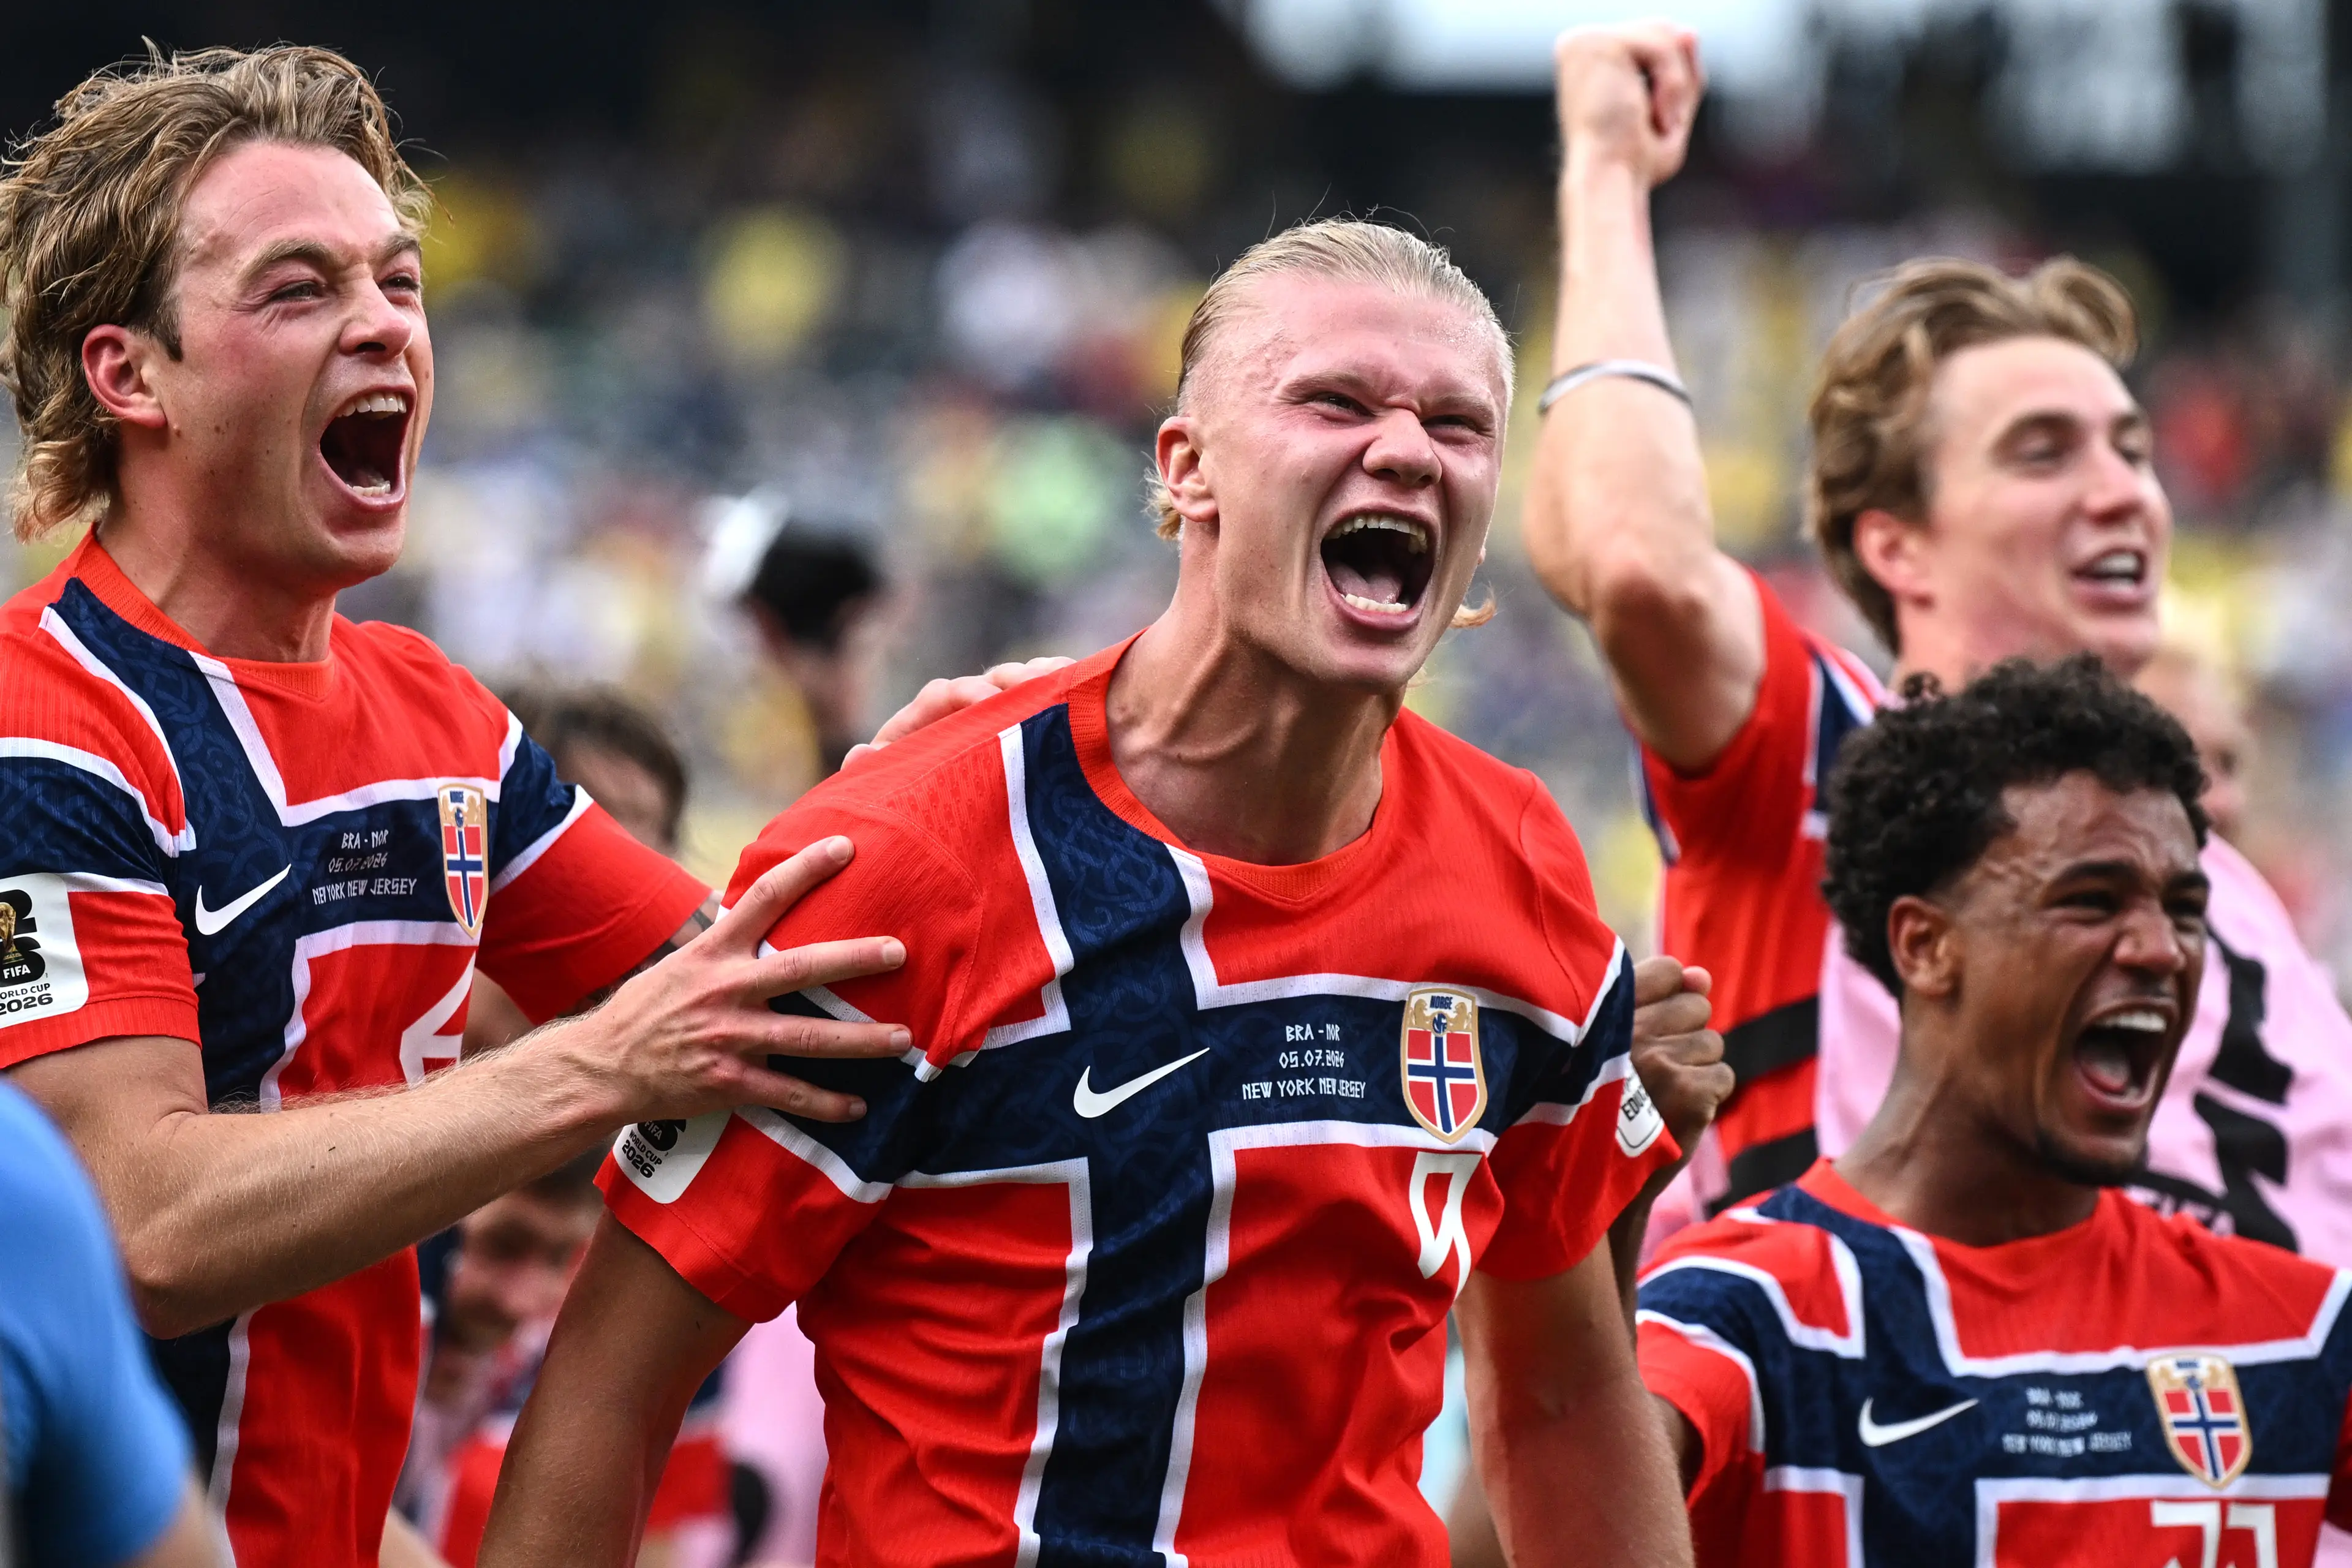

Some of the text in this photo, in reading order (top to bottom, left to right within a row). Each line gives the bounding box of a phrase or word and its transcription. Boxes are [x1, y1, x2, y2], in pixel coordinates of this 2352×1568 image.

[341, 832, 361, 849] BRA
[371, 829, 389, 848] NOR
[328, 852, 388, 873] 05.07.2026
[326, 881, 345, 902] YORK
[347, 879, 368, 897] NEW
[370, 878, 417, 895] JERSEY
[2, 964, 31, 979] FIFA
[30, 983, 51, 993] CUP
[1430, 995, 1453, 1009] NORGE
[1286, 1023, 1314, 1042] BRA
[1325, 1023, 1340, 1041] NOR
[1279, 1049, 1345, 1069] 05.07.2026
[1242, 1077, 1366, 1100] NEW YORK NEW JERSEY
[644, 1120, 662, 1140] FIFA
[629, 1129, 662, 1165] WORLD CUP
[622, 1139, 655, 1178] 2026
[1409, 1151, 1483, 1301] 9
